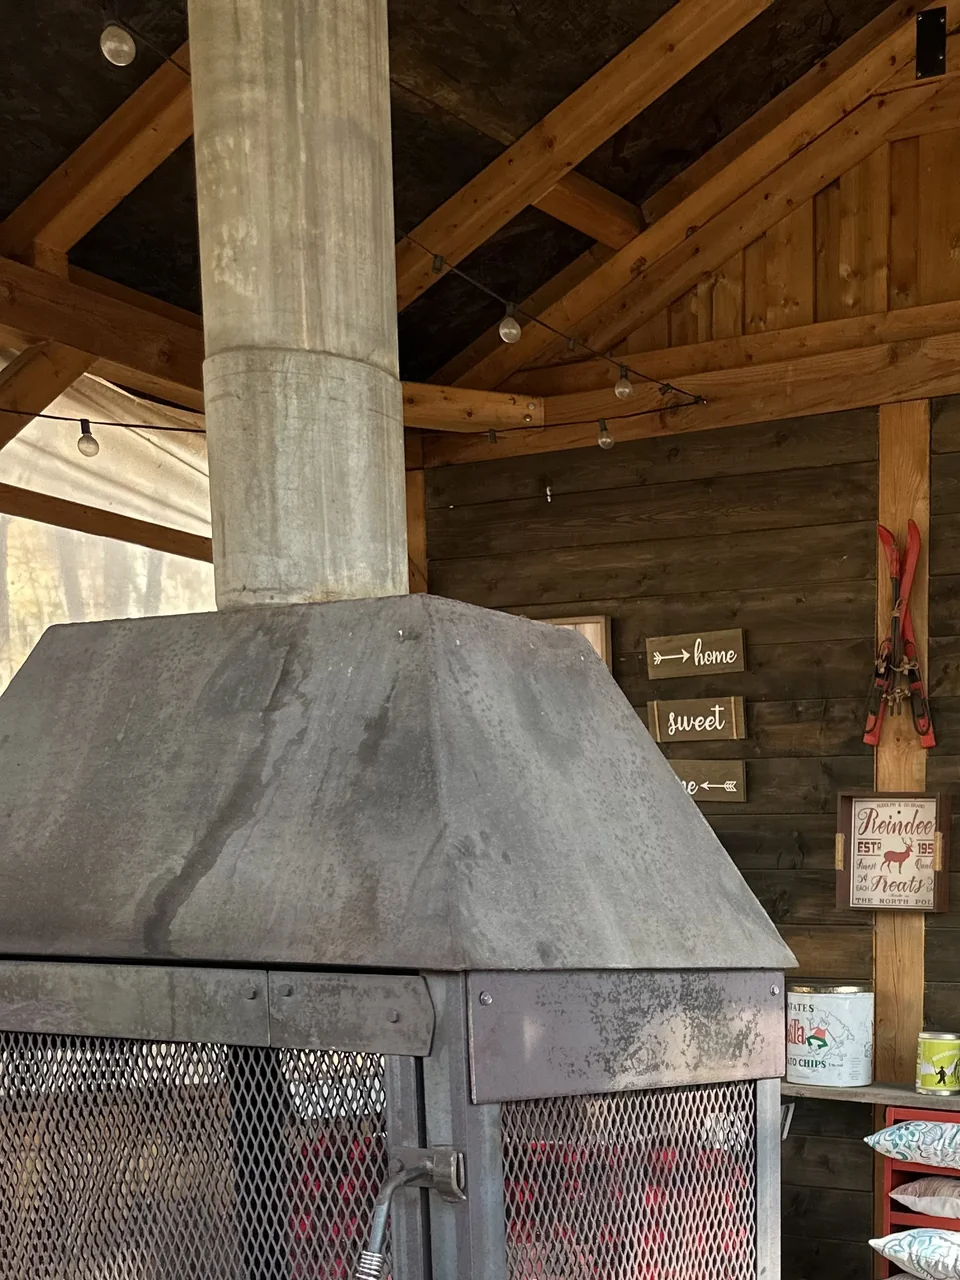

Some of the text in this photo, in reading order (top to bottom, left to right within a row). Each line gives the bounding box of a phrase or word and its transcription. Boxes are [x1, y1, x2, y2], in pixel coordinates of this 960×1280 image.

[693, 638, 737, 666] home
[667, 704, 726, 736] sweet
[857, 807, 936, 836] Reindee
[871, 875, 925, 894] Treats
[879, 897, 909, 905] NORTH
[915, 898, 933, 906] POL
[787, 1002, 815, 1013] TATES
[798, 1059, 827, 1069] CHIPS
